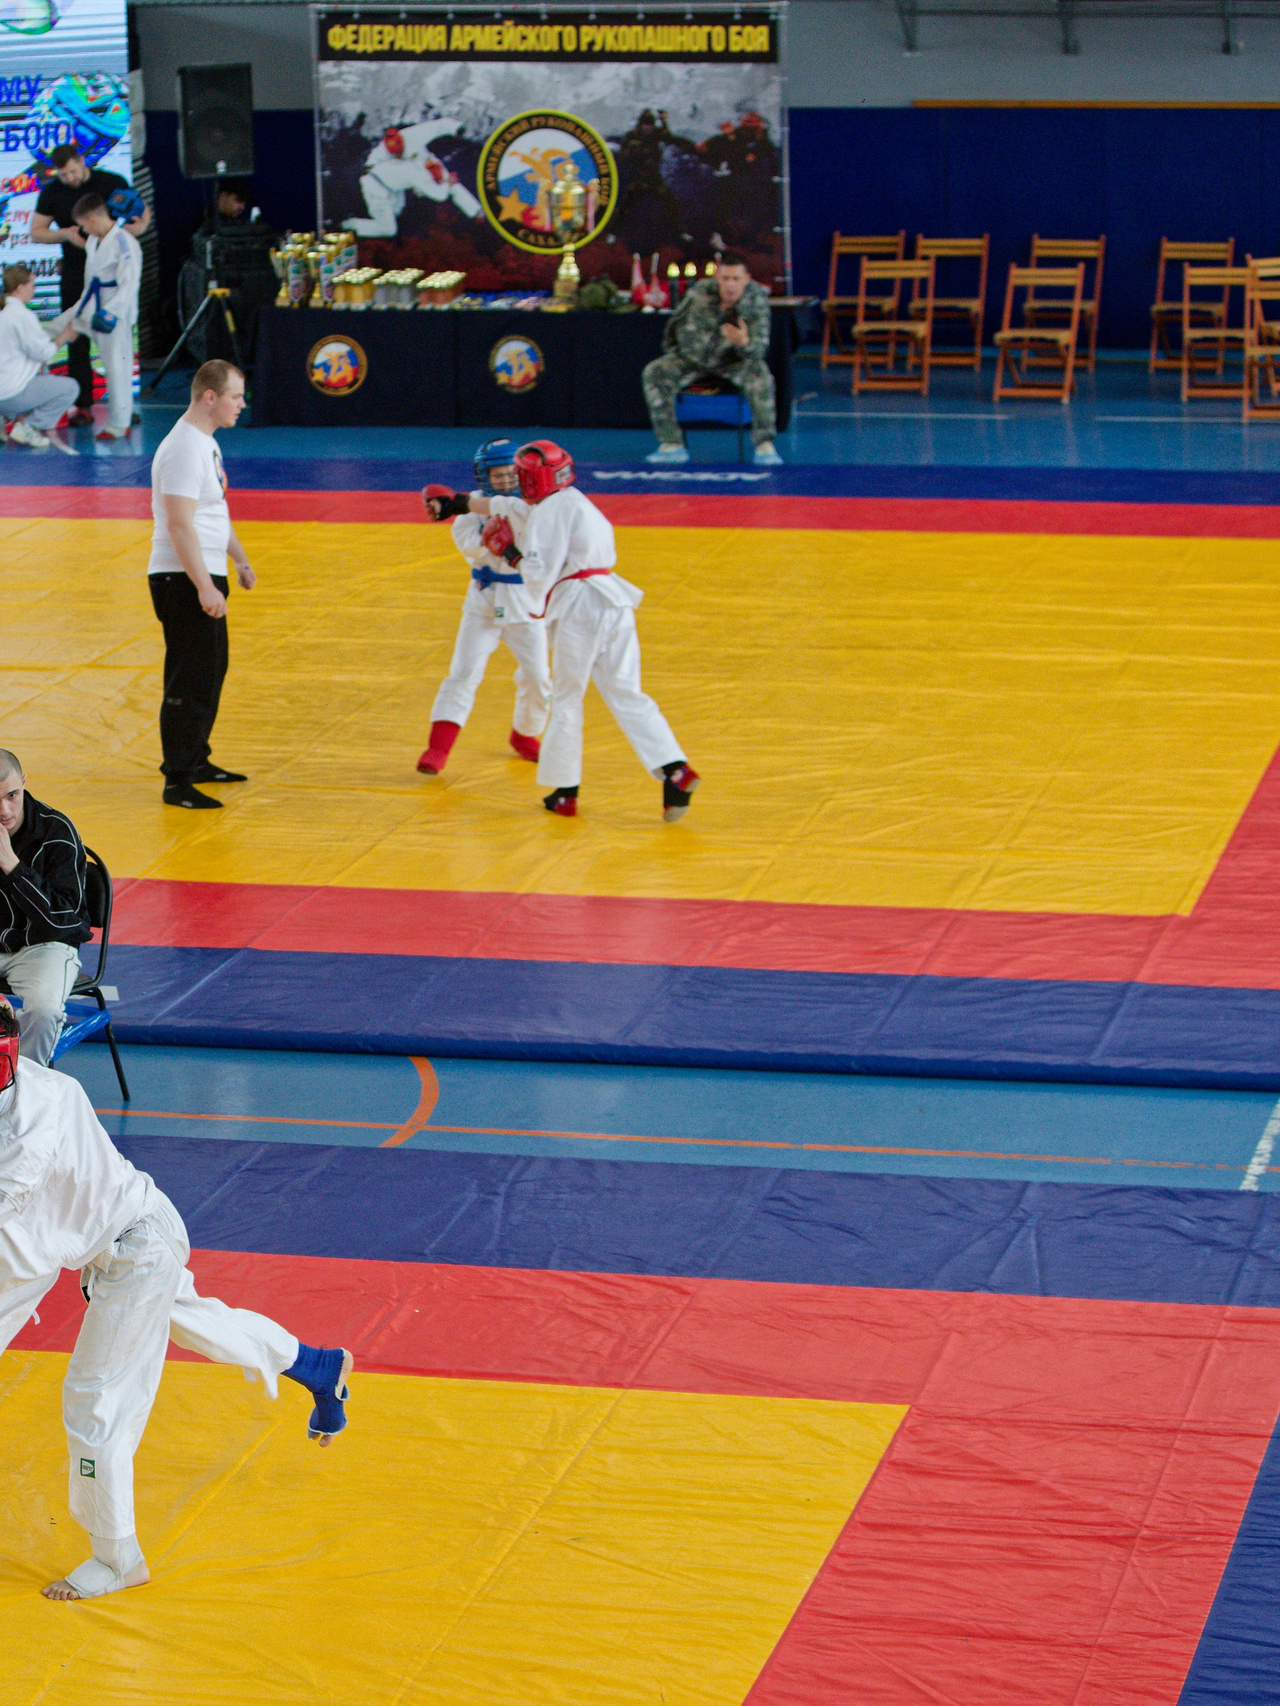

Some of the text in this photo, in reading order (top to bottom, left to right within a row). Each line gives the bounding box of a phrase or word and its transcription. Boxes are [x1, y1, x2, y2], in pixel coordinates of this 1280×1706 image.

[327, 20, 769, 53] ФЕДЕРАЦИЯ АРМЕЙСКОГО РУКОПАШНОГО БОЯ
[4, 122, 74, 151] БОЮ
